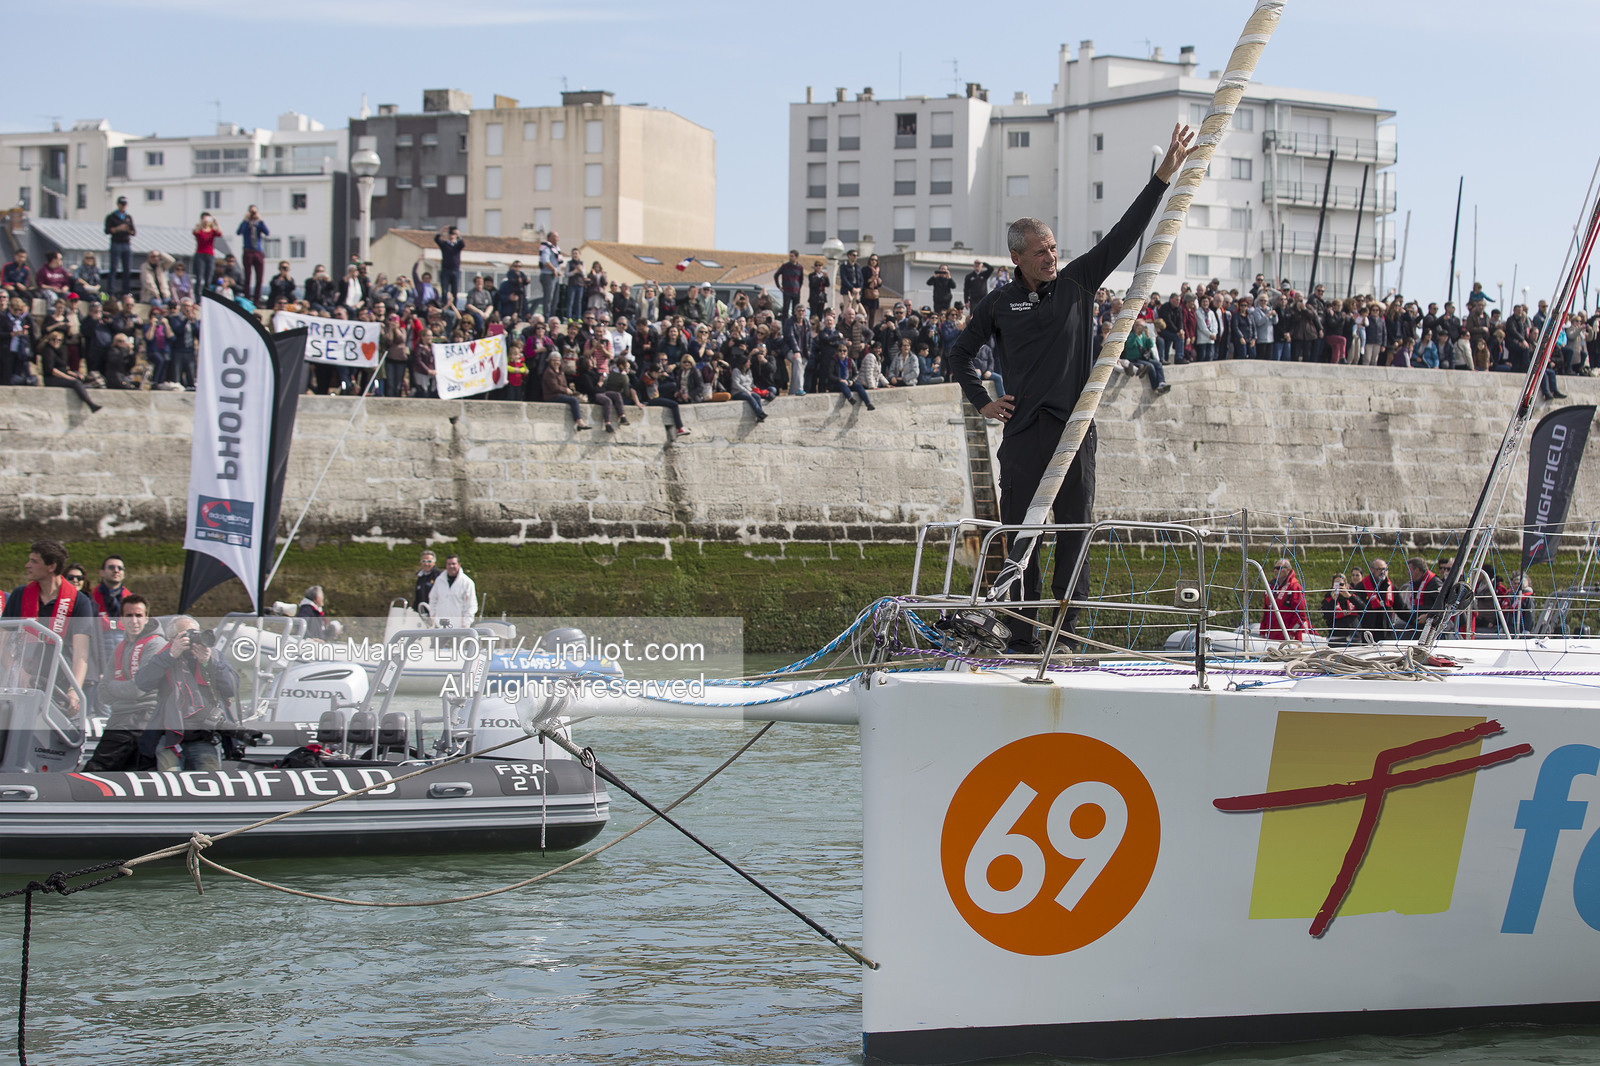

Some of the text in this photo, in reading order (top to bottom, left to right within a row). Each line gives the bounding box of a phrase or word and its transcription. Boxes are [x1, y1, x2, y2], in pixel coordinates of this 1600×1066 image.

[310, 340, 358, 360] SEB
[1534, 424, 1568, 536] HIGHFIELD
[520, 657, 567, 670] D4952
[281, 688, 346, 700] HONDA
[294, 722, 320, 731] FR
[480, 718, 522, 728] HON
[494, 763, 550, 776] FRA
[125, 769, 397, 797] HIGHFIELD
[511, 775, 541, 791] 21
[964, 780, 1129, 915] 69
